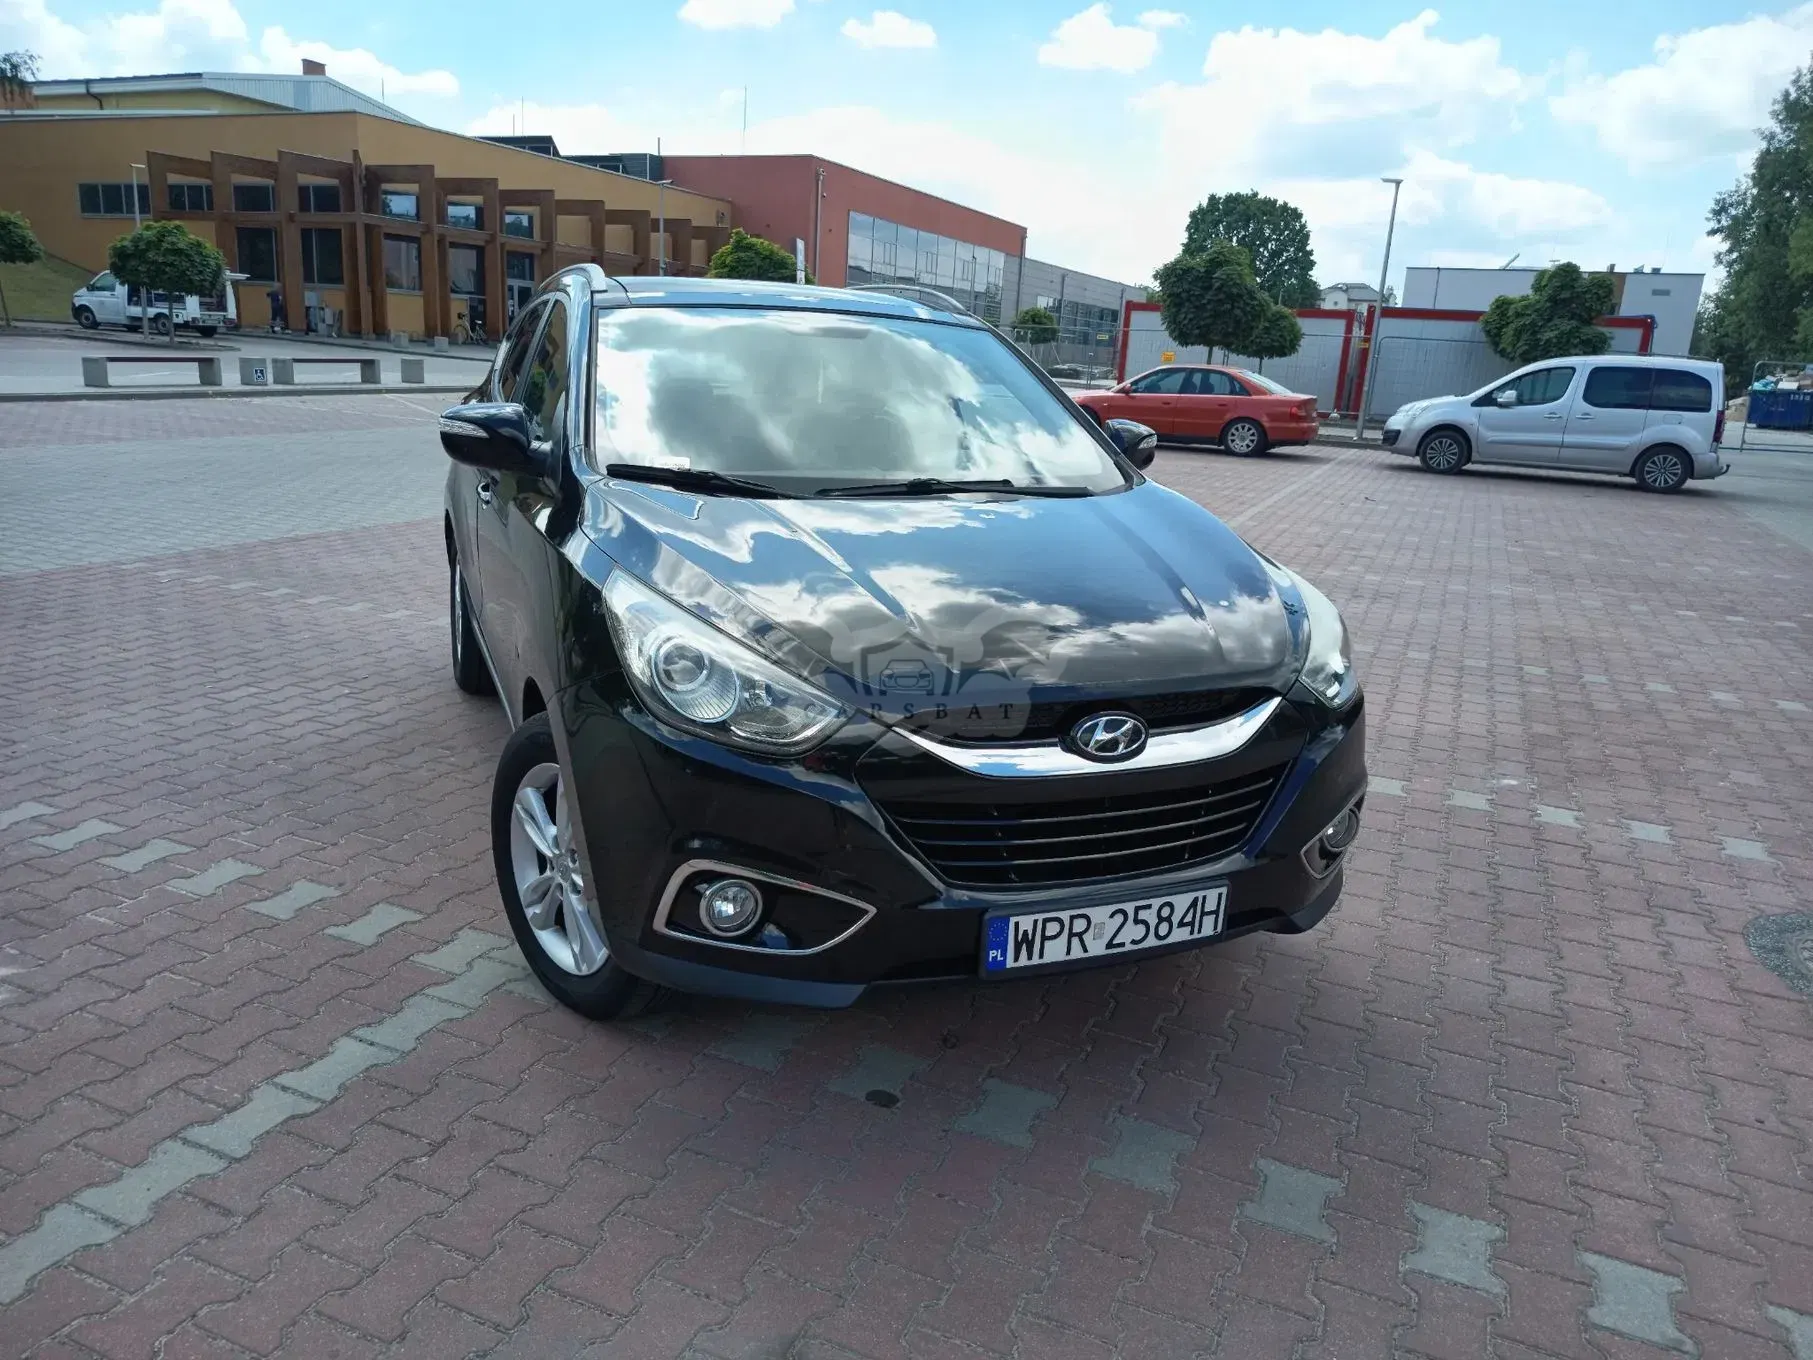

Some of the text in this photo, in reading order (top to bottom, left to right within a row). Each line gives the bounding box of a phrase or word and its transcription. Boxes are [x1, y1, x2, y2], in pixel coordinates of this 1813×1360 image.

[1013, 892, 1223, 963] WPR 2584H
[989, 950, 1004, 961] PL
